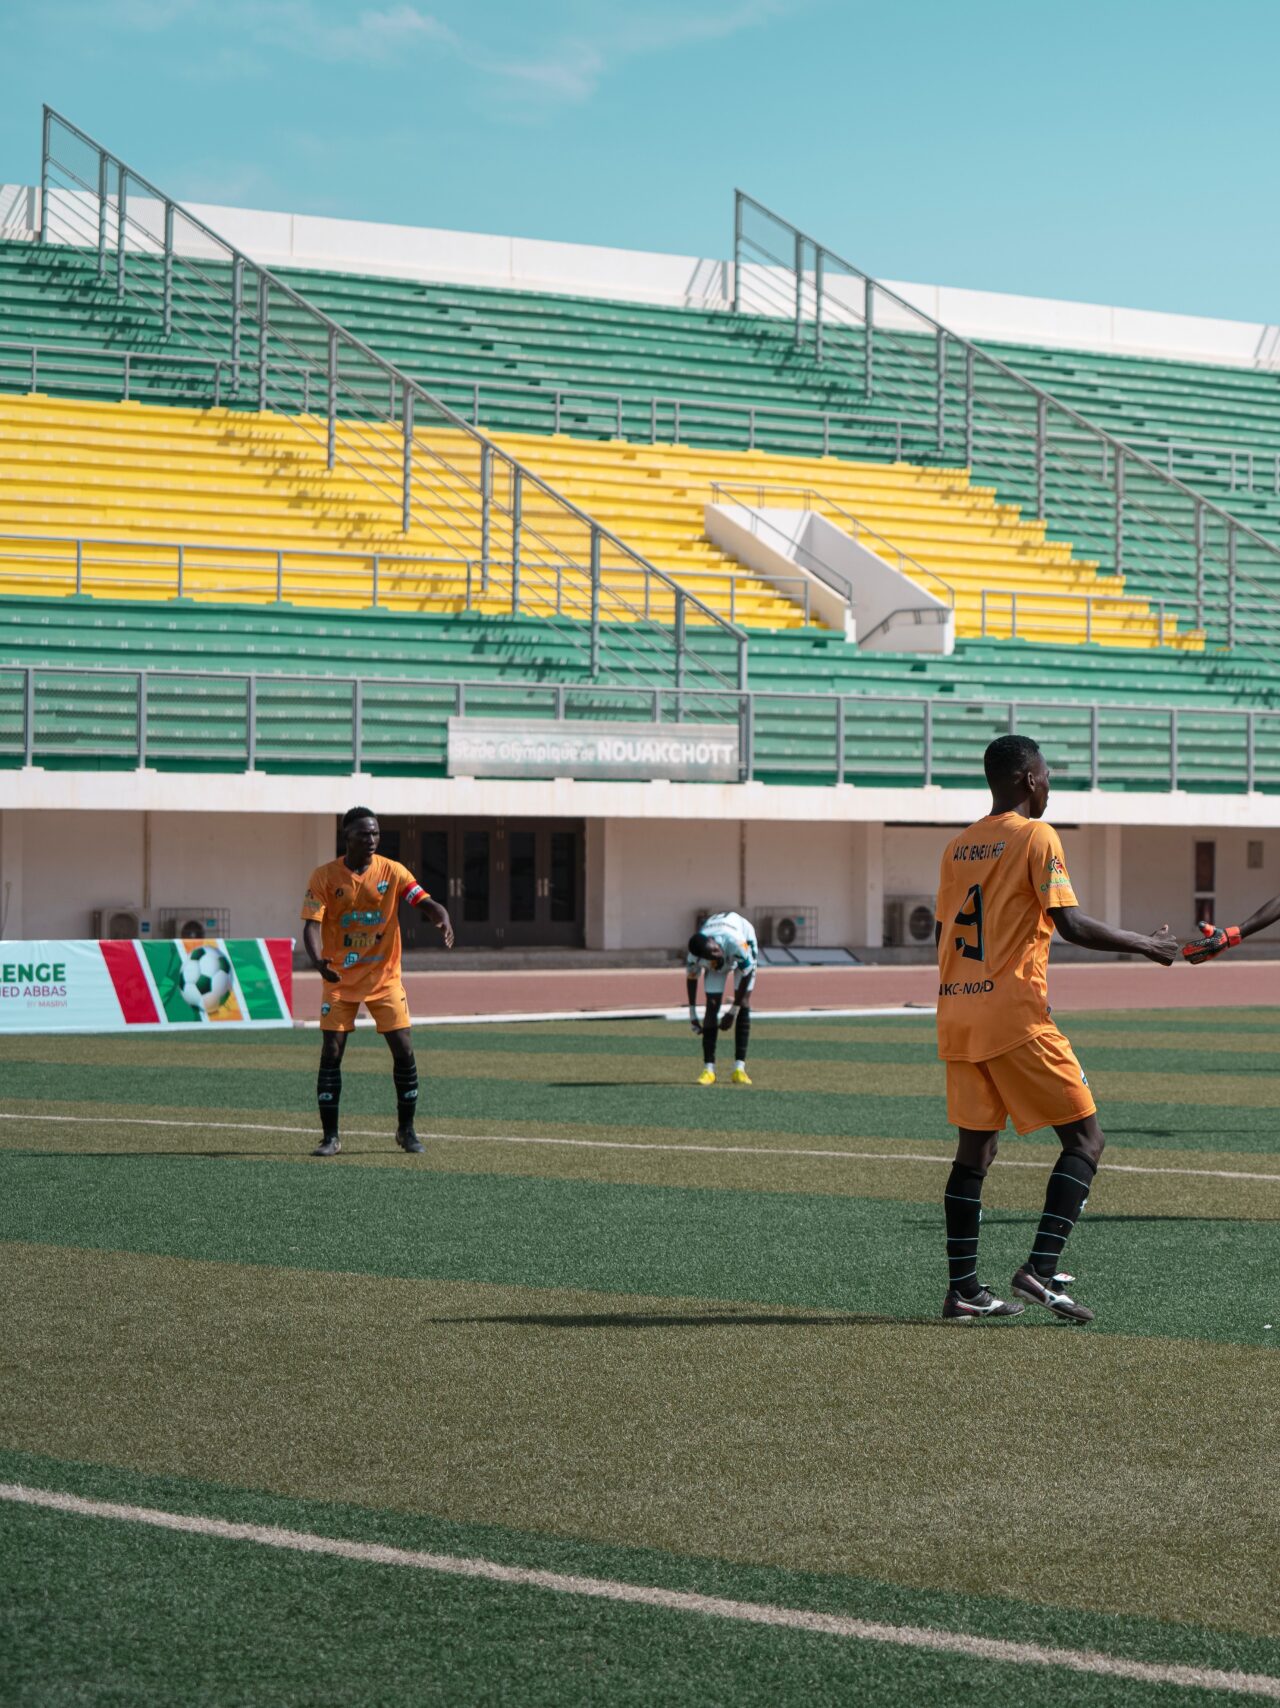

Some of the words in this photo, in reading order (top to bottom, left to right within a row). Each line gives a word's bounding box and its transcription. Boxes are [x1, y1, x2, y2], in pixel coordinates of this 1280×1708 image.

[499, 740, 578, 765] Olympique
[598, 739, 734, 764] NOUAKCHOTT
[954, 883, 984, 962] 9
[0, 963, 66, 982] ENGE
[0, 986, 20, 997] ED
[23, 985, 67, 997] ABBAS
